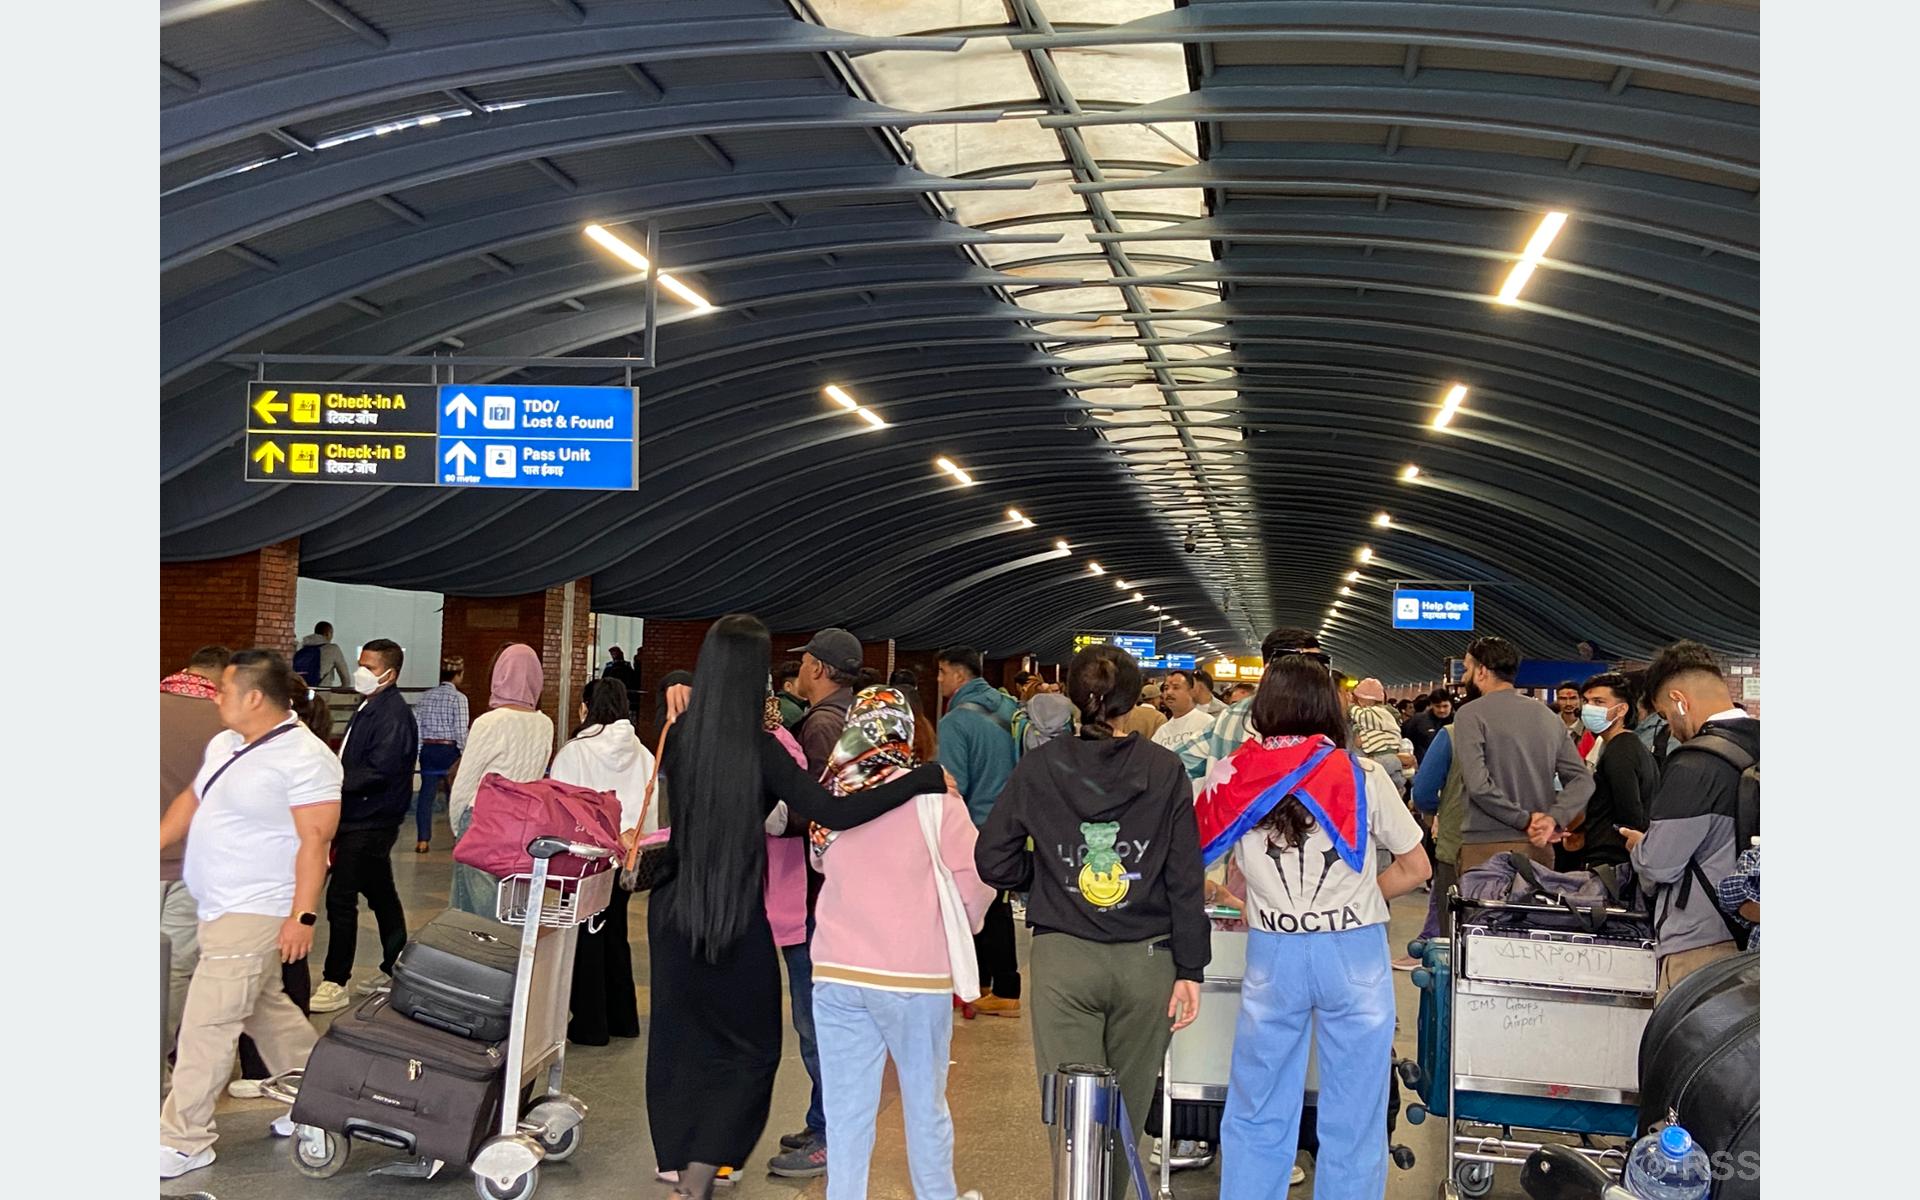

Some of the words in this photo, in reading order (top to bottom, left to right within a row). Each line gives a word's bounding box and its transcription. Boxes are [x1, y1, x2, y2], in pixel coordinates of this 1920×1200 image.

[326, 393, 392, 409] Check-in
[393, 394, 406, 409] A
[523, 399, 560, 413] TDO/
[523, 414, 553, 428] Lost
[556, 415, 568, 429] &
[571, 415, 614, 429] Found
[325, 443, 391, 459] Check-in
[394, 445, 406, 459] B
[523, 447, 556, 461] Pass
[559, 447, 591, 462] Unit
[1422, 601, 1444, 612] Help
[1260, 905, 1362, 933] NOCTA
